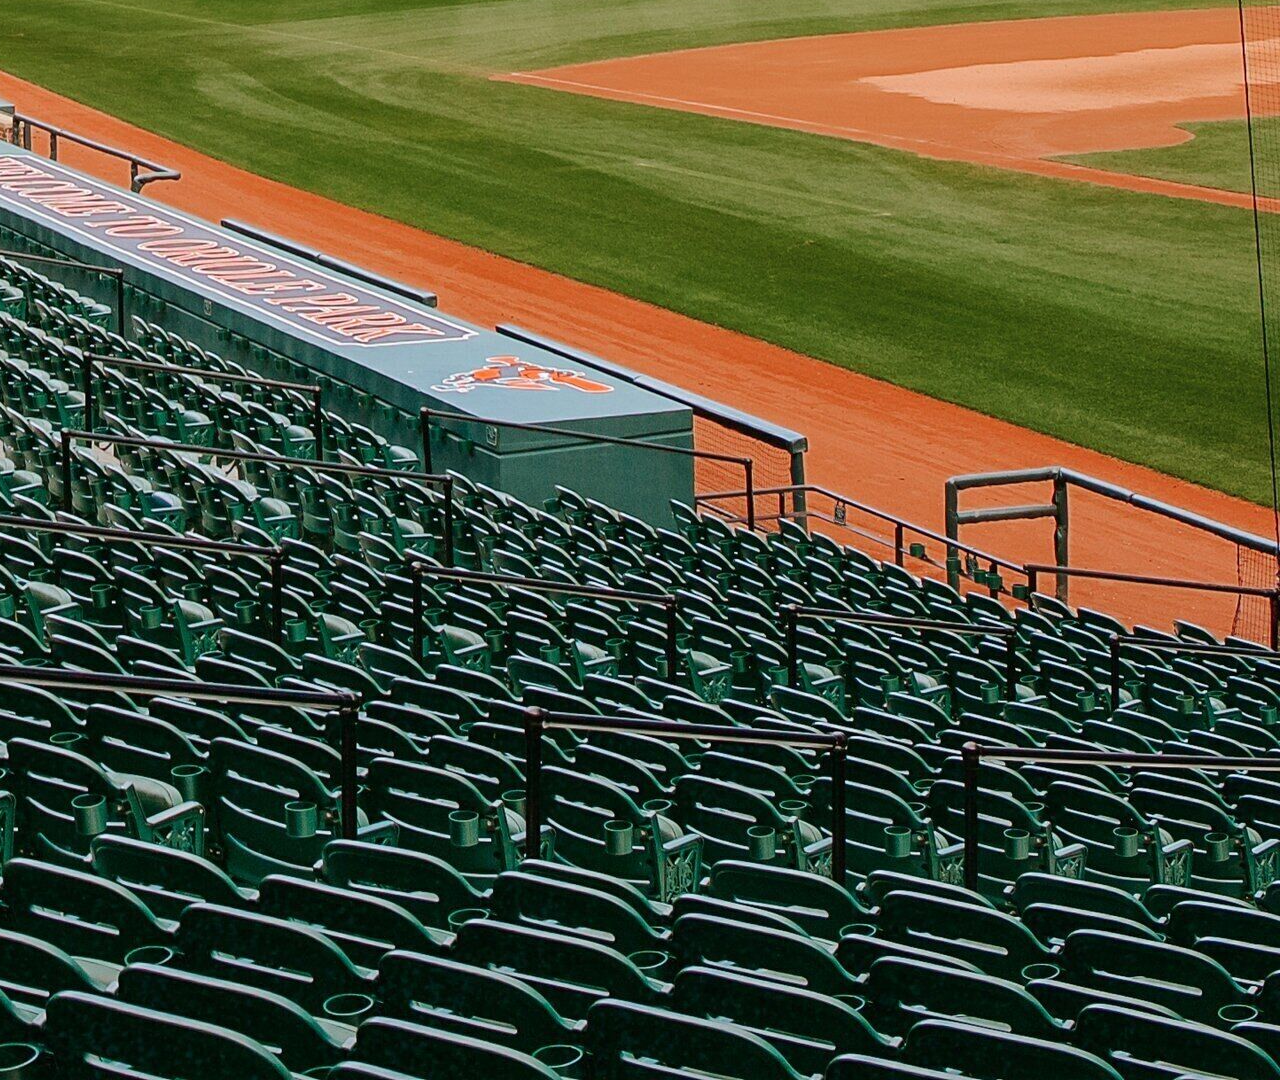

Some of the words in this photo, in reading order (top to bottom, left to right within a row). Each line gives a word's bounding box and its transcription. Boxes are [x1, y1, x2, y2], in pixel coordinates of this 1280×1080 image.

[83, 214, 186, 239] TO
[137, 239, 326, 296] ORIOLE
[282, 291, 447, 344] PARK
